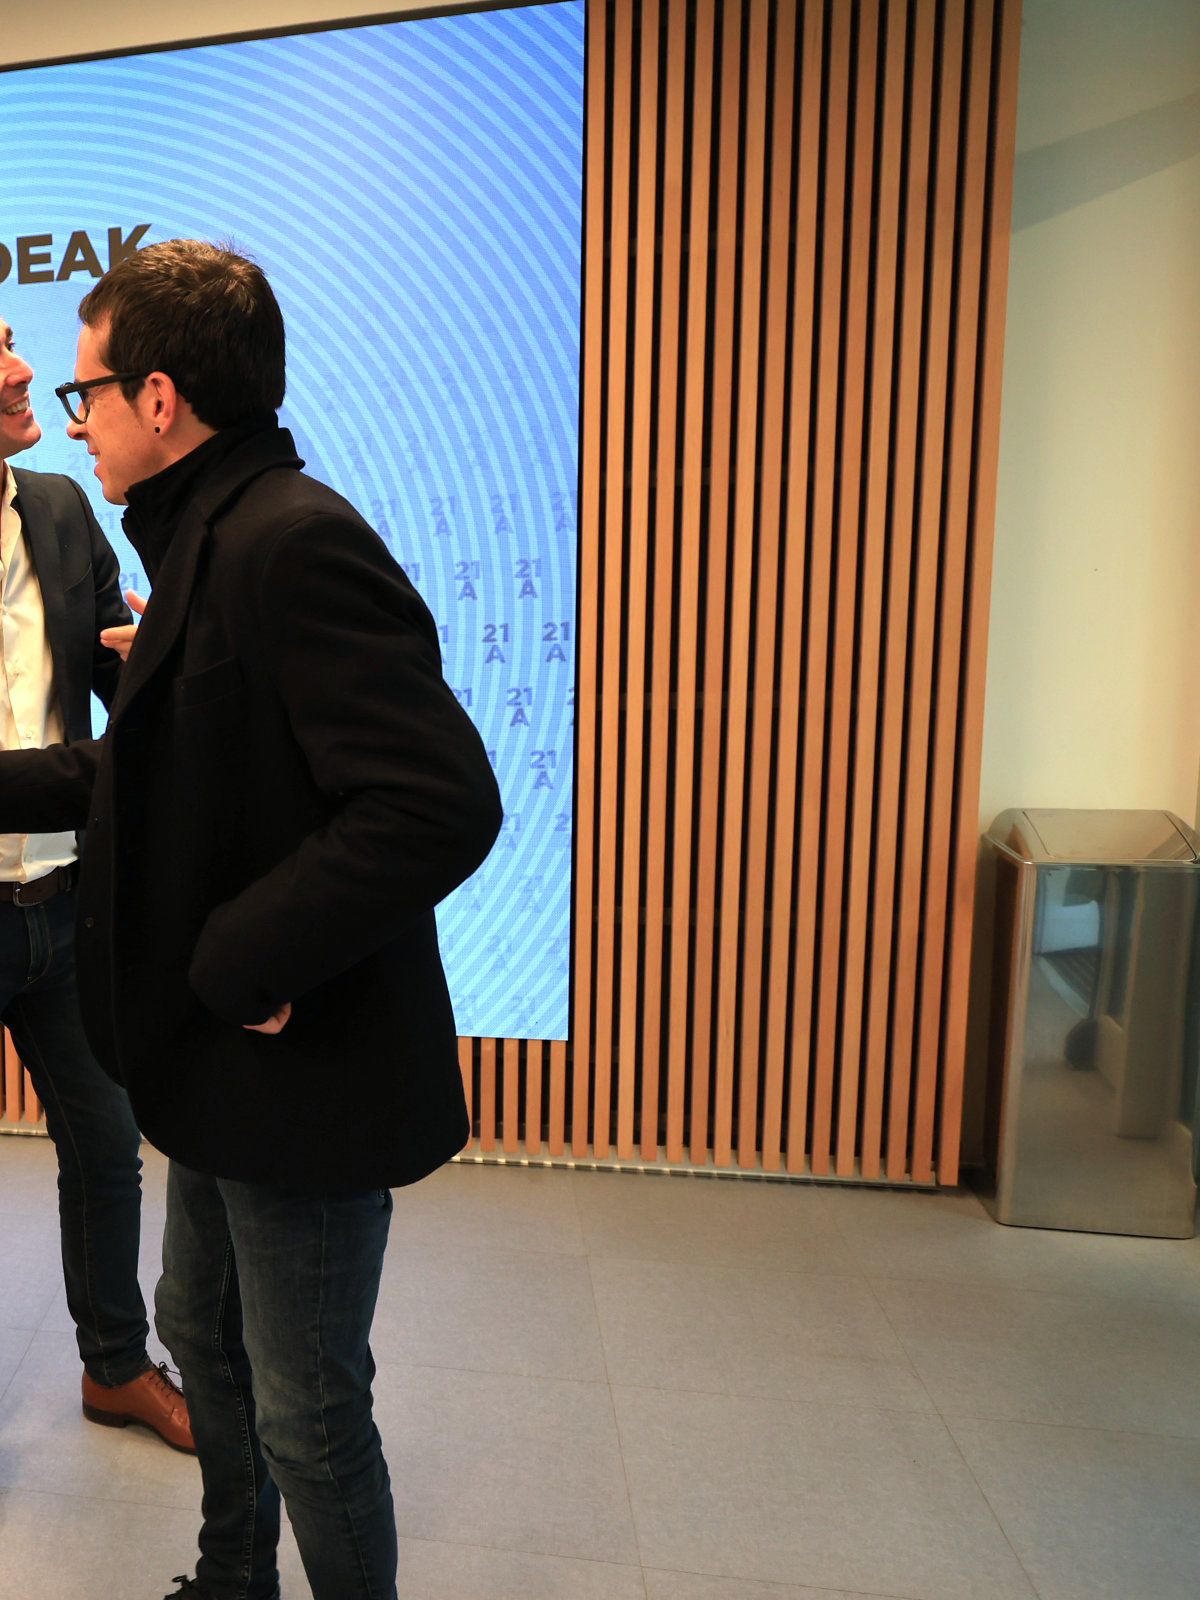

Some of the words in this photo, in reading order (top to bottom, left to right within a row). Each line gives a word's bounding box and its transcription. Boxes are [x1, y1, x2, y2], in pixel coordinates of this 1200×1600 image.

[371, 499, 395, 517] 21
[431, 497, 455, 515] 21
[491, 494, 516, 513] 21
[552, 492, 577, 511] 21
[378, 519, 391, 538] A
[435, 517, 451, 535] A
[495, 515, 513, 534] A
[556, 513, 574, 531] A
[456, 561, 480, 580] 21
[515, 559, 541, 578] 21
[458, 581, 477, 600] A
[519, 579, 538, 598] A
[482, 624, 509, 642] 21
[542, 622, 570, 641] 21
[485, 645, 505, 663] A
[546, 644, 566, 662] A
[506, 688, 533, 705] 21
[510, 708, 530, 726] A
[530, 751, 556, 768] 21
[534, 771, 552, 789] A
